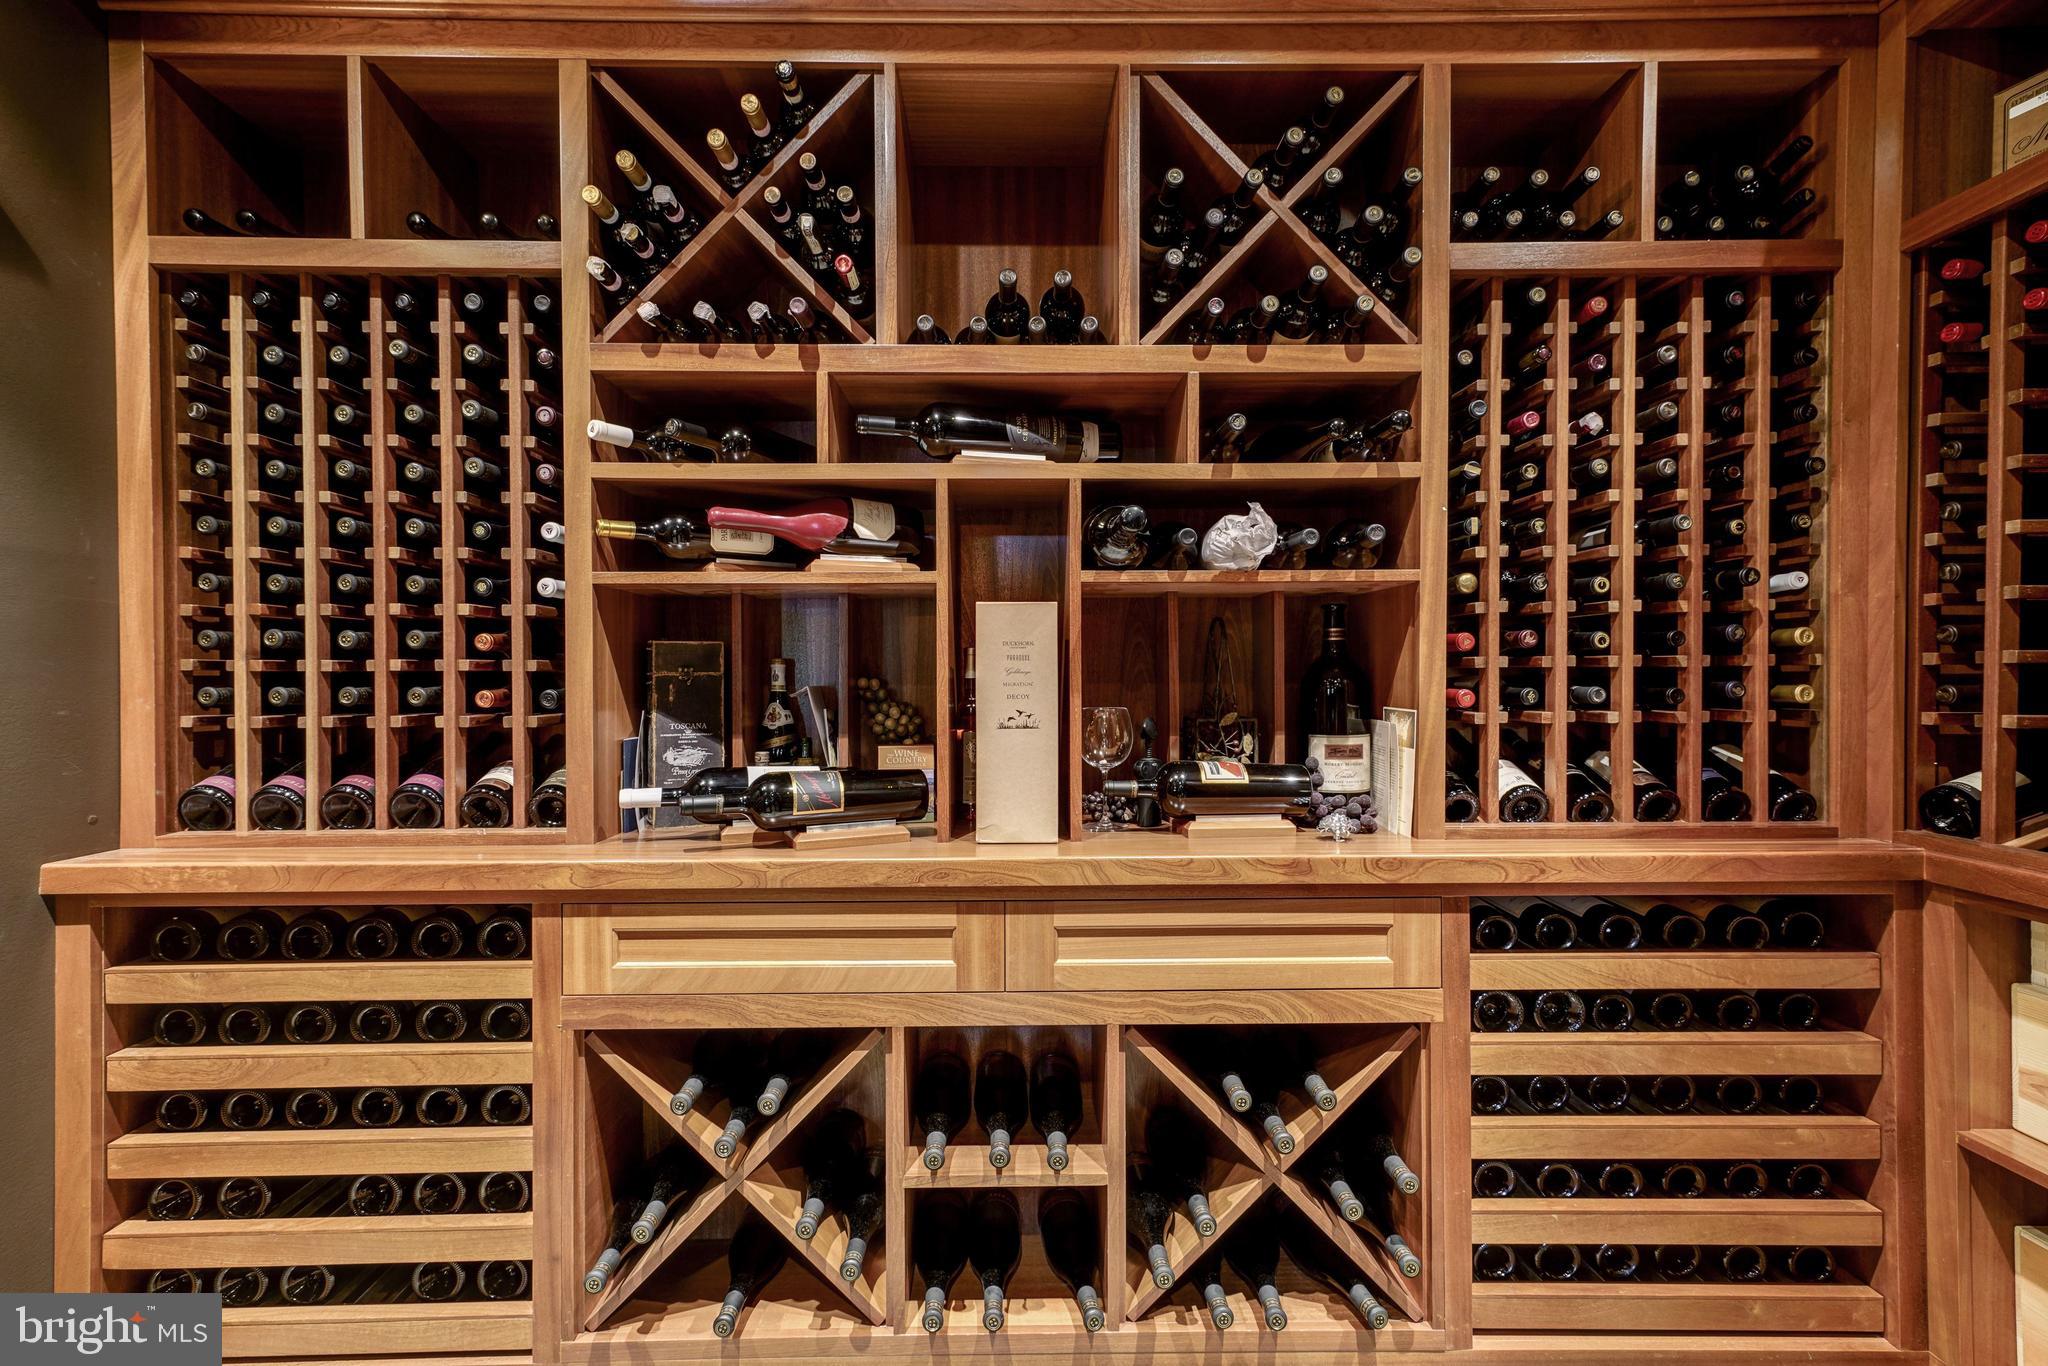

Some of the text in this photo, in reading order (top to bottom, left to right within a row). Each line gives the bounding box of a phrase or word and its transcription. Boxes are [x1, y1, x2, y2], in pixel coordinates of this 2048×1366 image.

[668, 722, 708, 730] TOSCANA
[894, 749, 920, 757] WINE
[886, 755, 928, 764] COUNTRY
